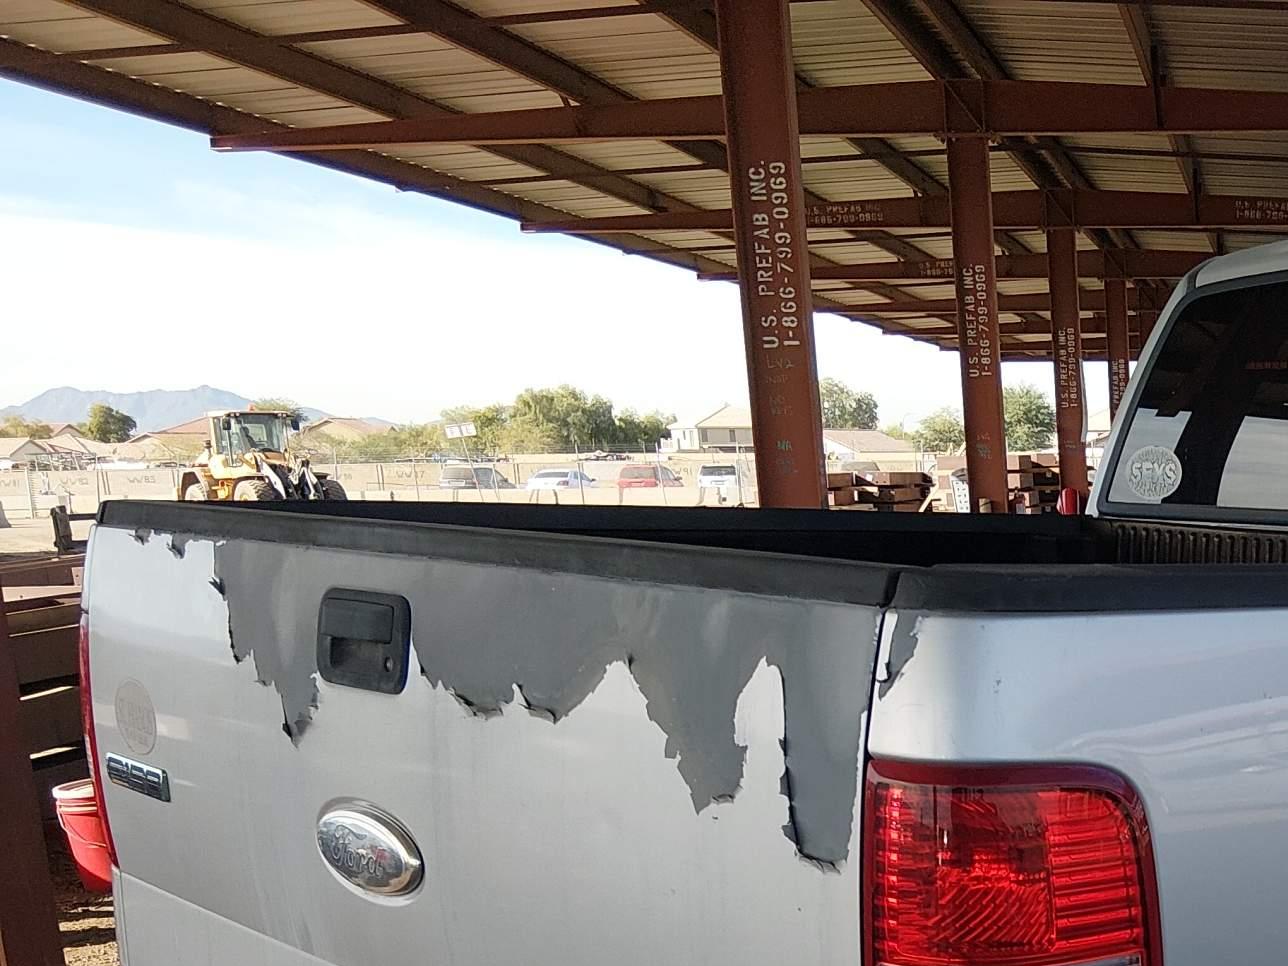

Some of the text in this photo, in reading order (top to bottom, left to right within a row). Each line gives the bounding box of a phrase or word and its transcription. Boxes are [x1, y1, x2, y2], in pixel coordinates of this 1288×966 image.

[749, 160, 779, 349] U.S. PREFAB INC.
[769, 161, 801, 347] 1-866-799-0969
[962, 263, 980, 377] U.S. PREFAB INC.
[974, 264, 993, 376] 1-866-799-0969
[331, 824, 384, 878] Ford
